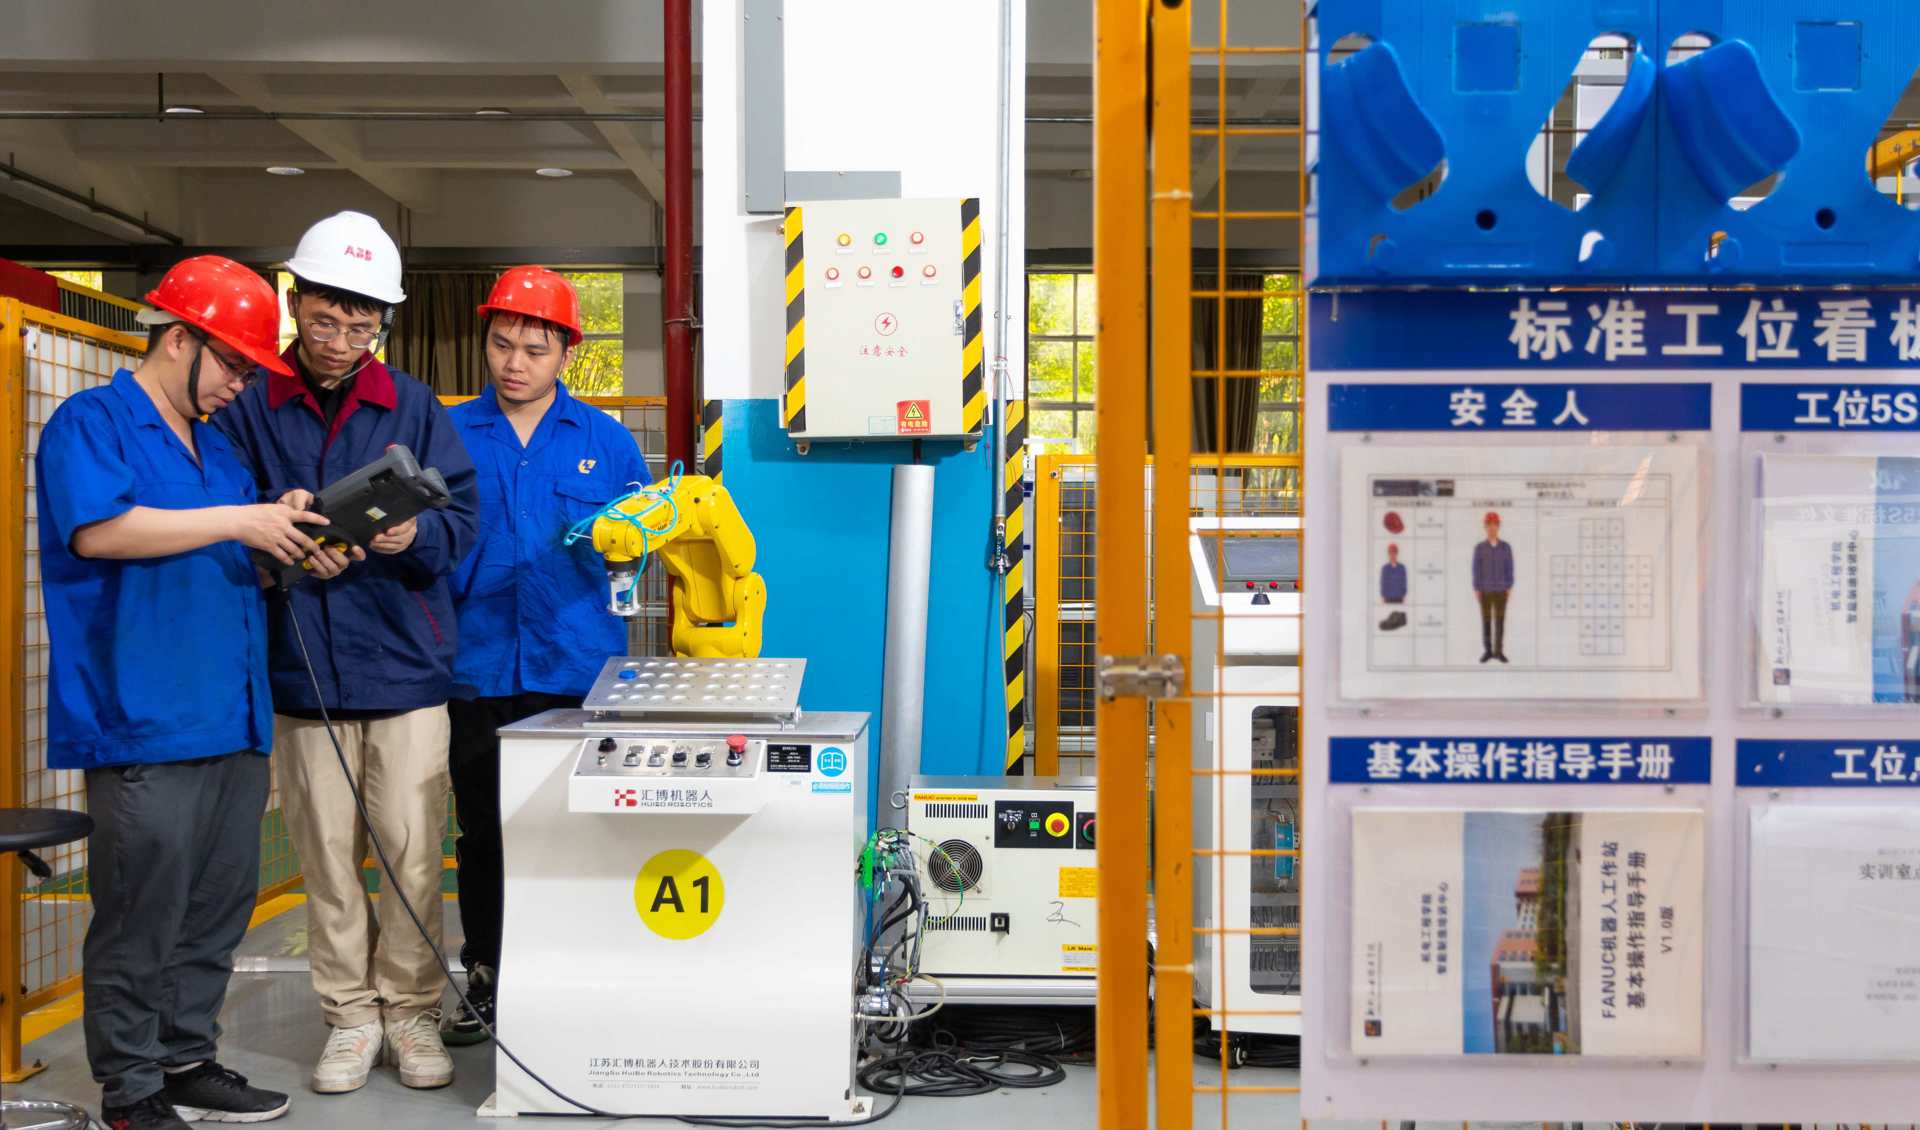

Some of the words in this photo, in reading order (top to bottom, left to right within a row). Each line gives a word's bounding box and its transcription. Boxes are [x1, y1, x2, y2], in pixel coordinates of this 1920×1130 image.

[344, 245, 372, 261] ABB
[860, 345, 908, 357] 注意安全
[1449, 389, 1590, 427] 安全人
[1794, 391, 1919, 426] 工位5S
[1367, 742, 1674, 780] 基本操作指导手册
[641, 789, 712, 801] 汇博机器人
[650, 875, 710, 913] A1
[1601, 841, 1619, 1019] FANUC机器人工作站
[1627, 851, 1646, 1009] 基本操作指导手册
[1659, 906, 1674, 954] V1.0版
[589, 1058, 760, 1069] 江苏汇博机器人技术股份有限公司
